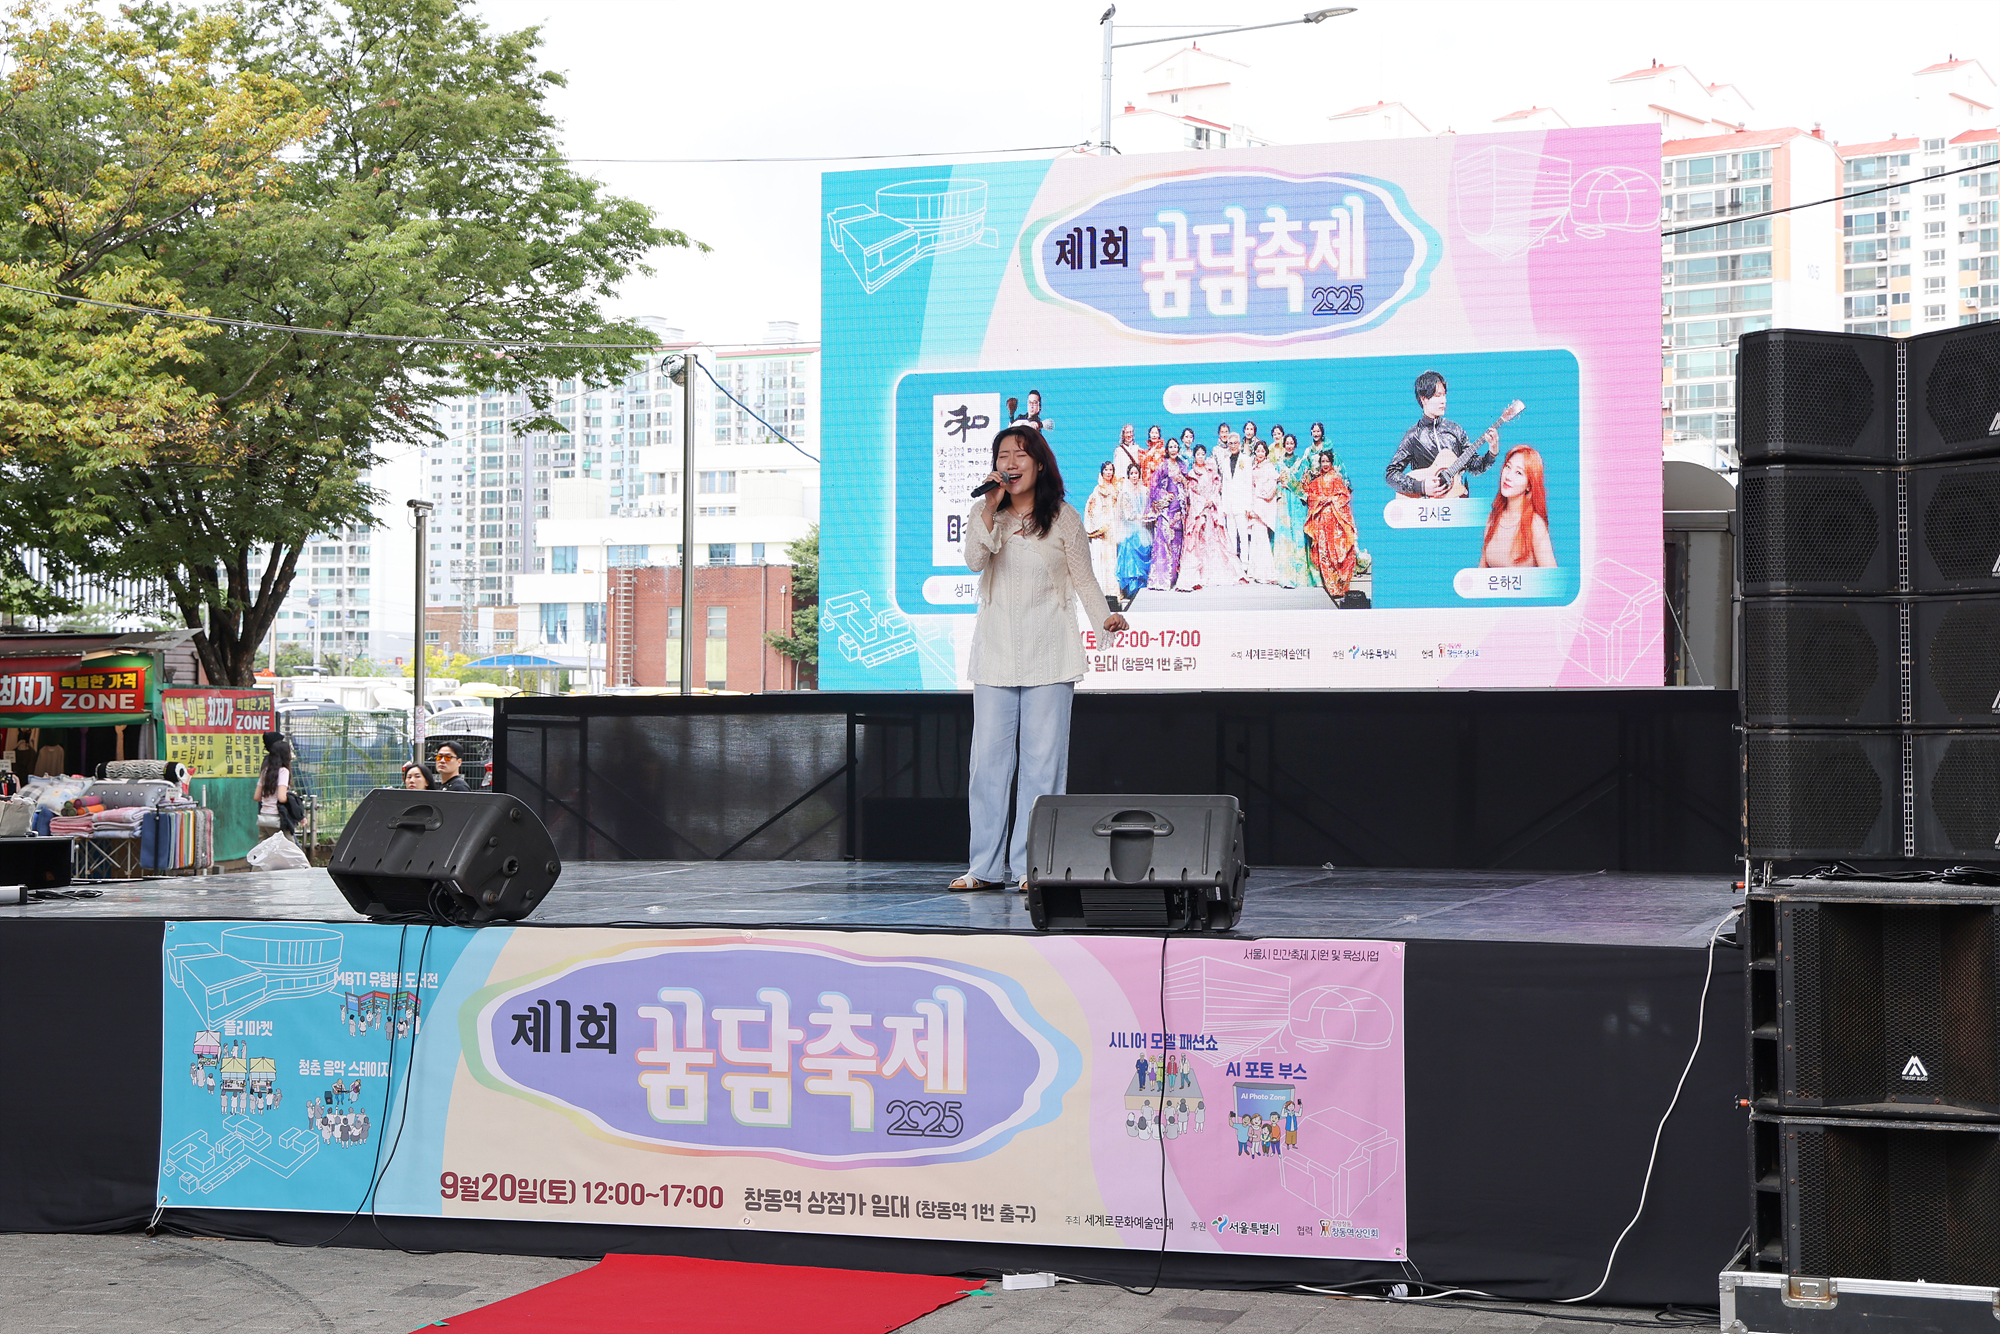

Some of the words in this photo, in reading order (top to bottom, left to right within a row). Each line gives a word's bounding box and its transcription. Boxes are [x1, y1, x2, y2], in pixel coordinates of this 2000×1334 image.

[1055, 225, 1129, 270] 제1회
[1141, 193, 1367, 319] 꿈담축제
[1190, 389, 1266, 407] 시니어모델협회
[944, 404, 990, 443] 和
[1418, 506, 1452, 522] 김시온
[1487, 575, 1522, 591] 은하진
[1111, 630, 1201, 648] 2:00~17:00
[1094, 655, 1118, 672] 일대
[1121, 657, 1154, 671] (창동역
[1156, 657, 1171, 671] 1번
[1173, 656, 1197, 672] 출구)
[61, 674, 105, 689] 특별한
[108, 672, 137, 689] 가격
[0, 675, 54, 706] 최저가
[61, 693, 136, 709] ZONE
[236, 698, 257, 711] 특별한
[257, 696, 271, 711] 가격
[207, 696, 234, 727] 최저가
[235, 715, 270, 730] ZONE
[1243, 948, 1271, 960] 서울시
[1272, 948, 1309, 961] 민간축제
[1310, 949, 1329, 961] 지원
[1331, 949, 1341, 961] 및
[1343, 949, 1380, 962] 육성사업
[333, 971, 367, 986] MBTI
[368, 971, 402, 988] 유형별
[404, 972, 439, 989] 도서전
[224, 1019, 273, 1037] 플리마켓
[1109, 1031, 1147, 1049] 시니어
[1150, 1032, 1176, 1050] 모델
[1179, 1033, 1219, 1051] 패션쇼
[511, 999, 617, 1055] 제1회
[635, 985, 968, 1133] 꿈담축제
[298, 1059, 321, 1076] 청춘
[323, 1060, 347, 1077] 음악
[347, 1061, 393, 1078] 스테이지
[1226, 1061, 1241, 1077] AI
[1244, 1062, 1275, 1079] 포토
[1278, 1063, 1308, 1080] 부스
[1241, 1092, 1249, 1100] AI
[1249, 1092, 1269, 1101] Photo
[1269, 1093, 1287, 1101] Zone
[886, 1099, 964, 1139] 2025
[440, 1171, 577, 1205] 9월20일(토)
[582, 1181, 724, 1209] 12:00~17:00
[744, 1187, 802, 1214] 창동역
[807, 1190, 867, 1217] 상점가
[871, 1194, 910, 1219] 일대
[915, 1200, 967, 1221] (창동역
[971, 1203, 995, 1222] 1번
[999, 1203, 1037, 1224] 출구)
[1065, 1215, 1081, 1226] 주최
[1084, 1213, 1174, 1231] 세계로문화예술연대
[1190, 1221, 1206, 1232] 후원
[1228, 1221, 1280, 1236] 서울특별시
[1296, 1225, 1313, 1237] 협력
